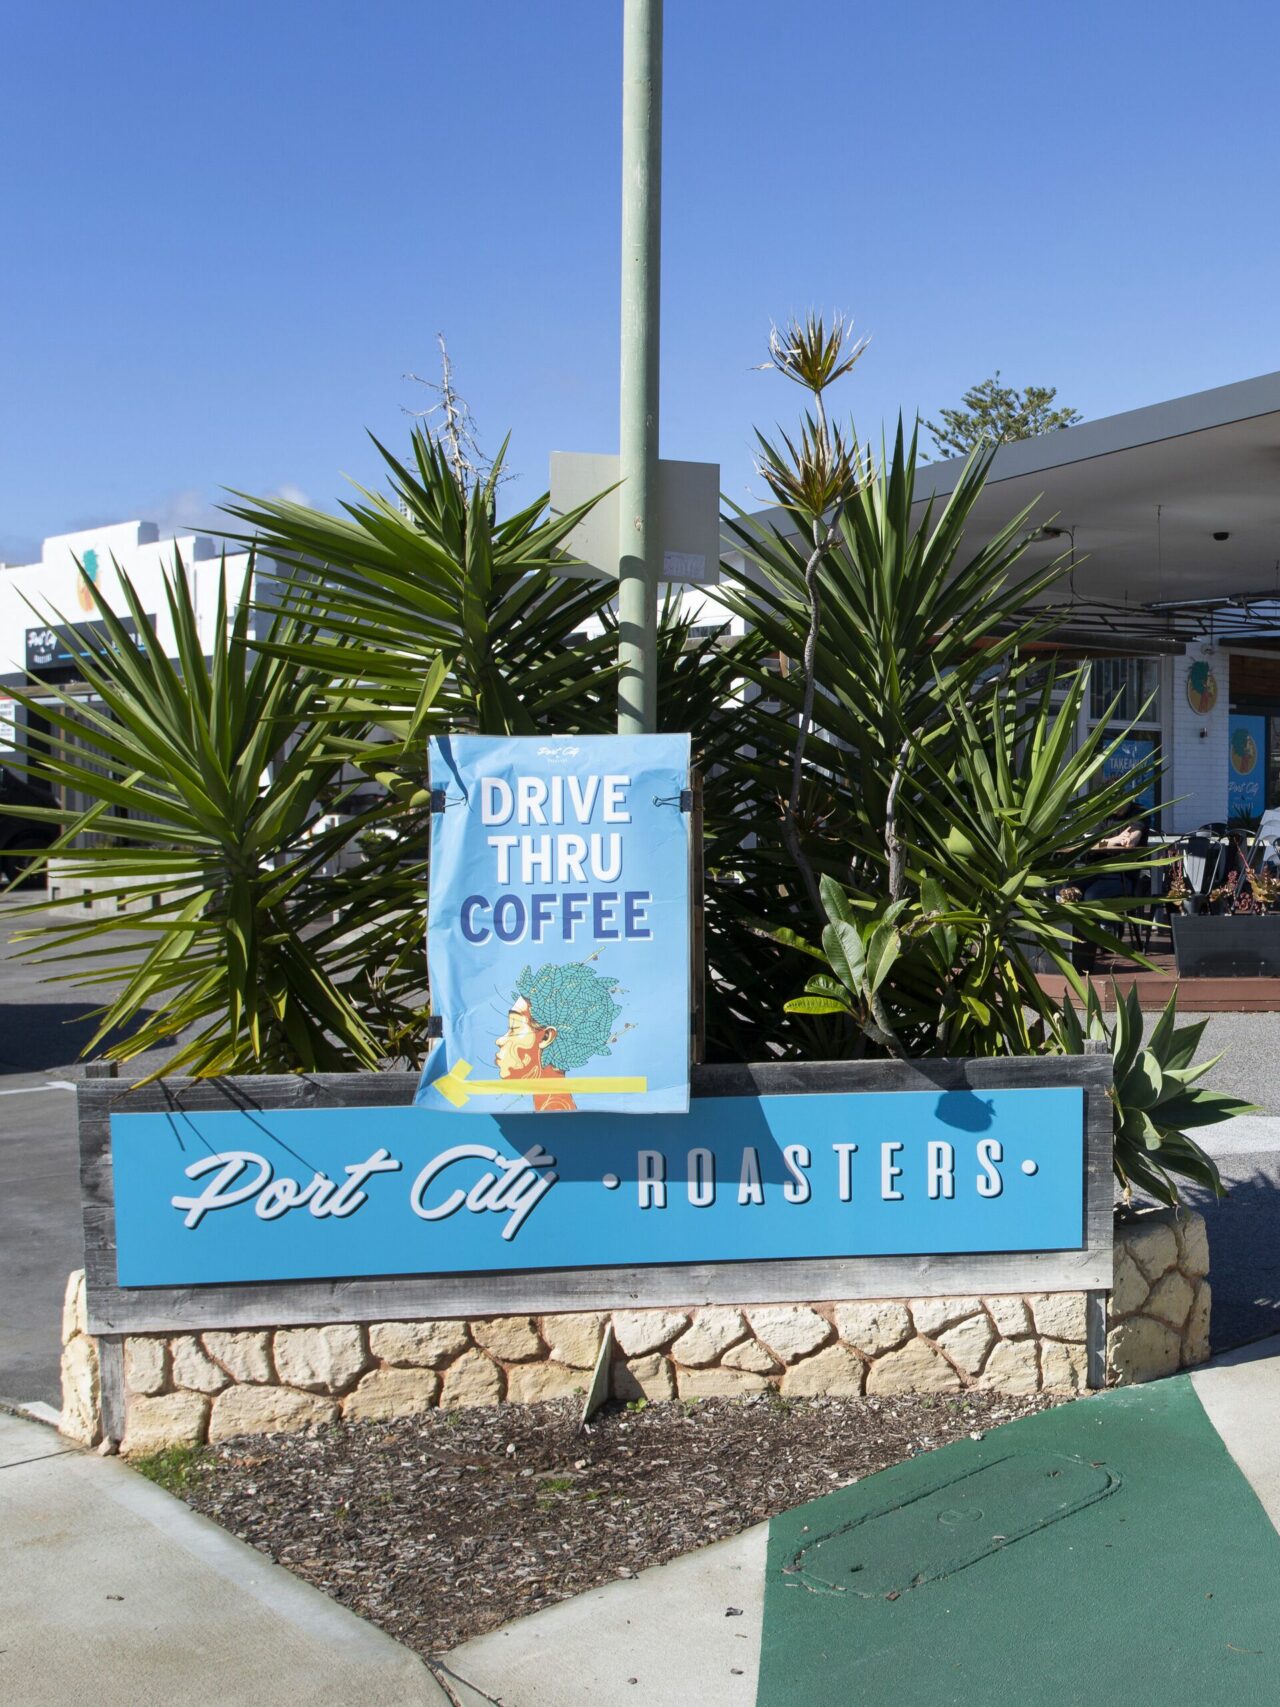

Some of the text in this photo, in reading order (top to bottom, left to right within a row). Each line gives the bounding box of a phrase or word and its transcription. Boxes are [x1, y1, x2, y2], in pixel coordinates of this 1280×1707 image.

[481, 774, 633, 826] DRIVE
[487, 832, 623, 885] THRU
[460, 890, 654, 946] COFFEE
[171, 1138, 1005, 1242] Port City ROASTERS
